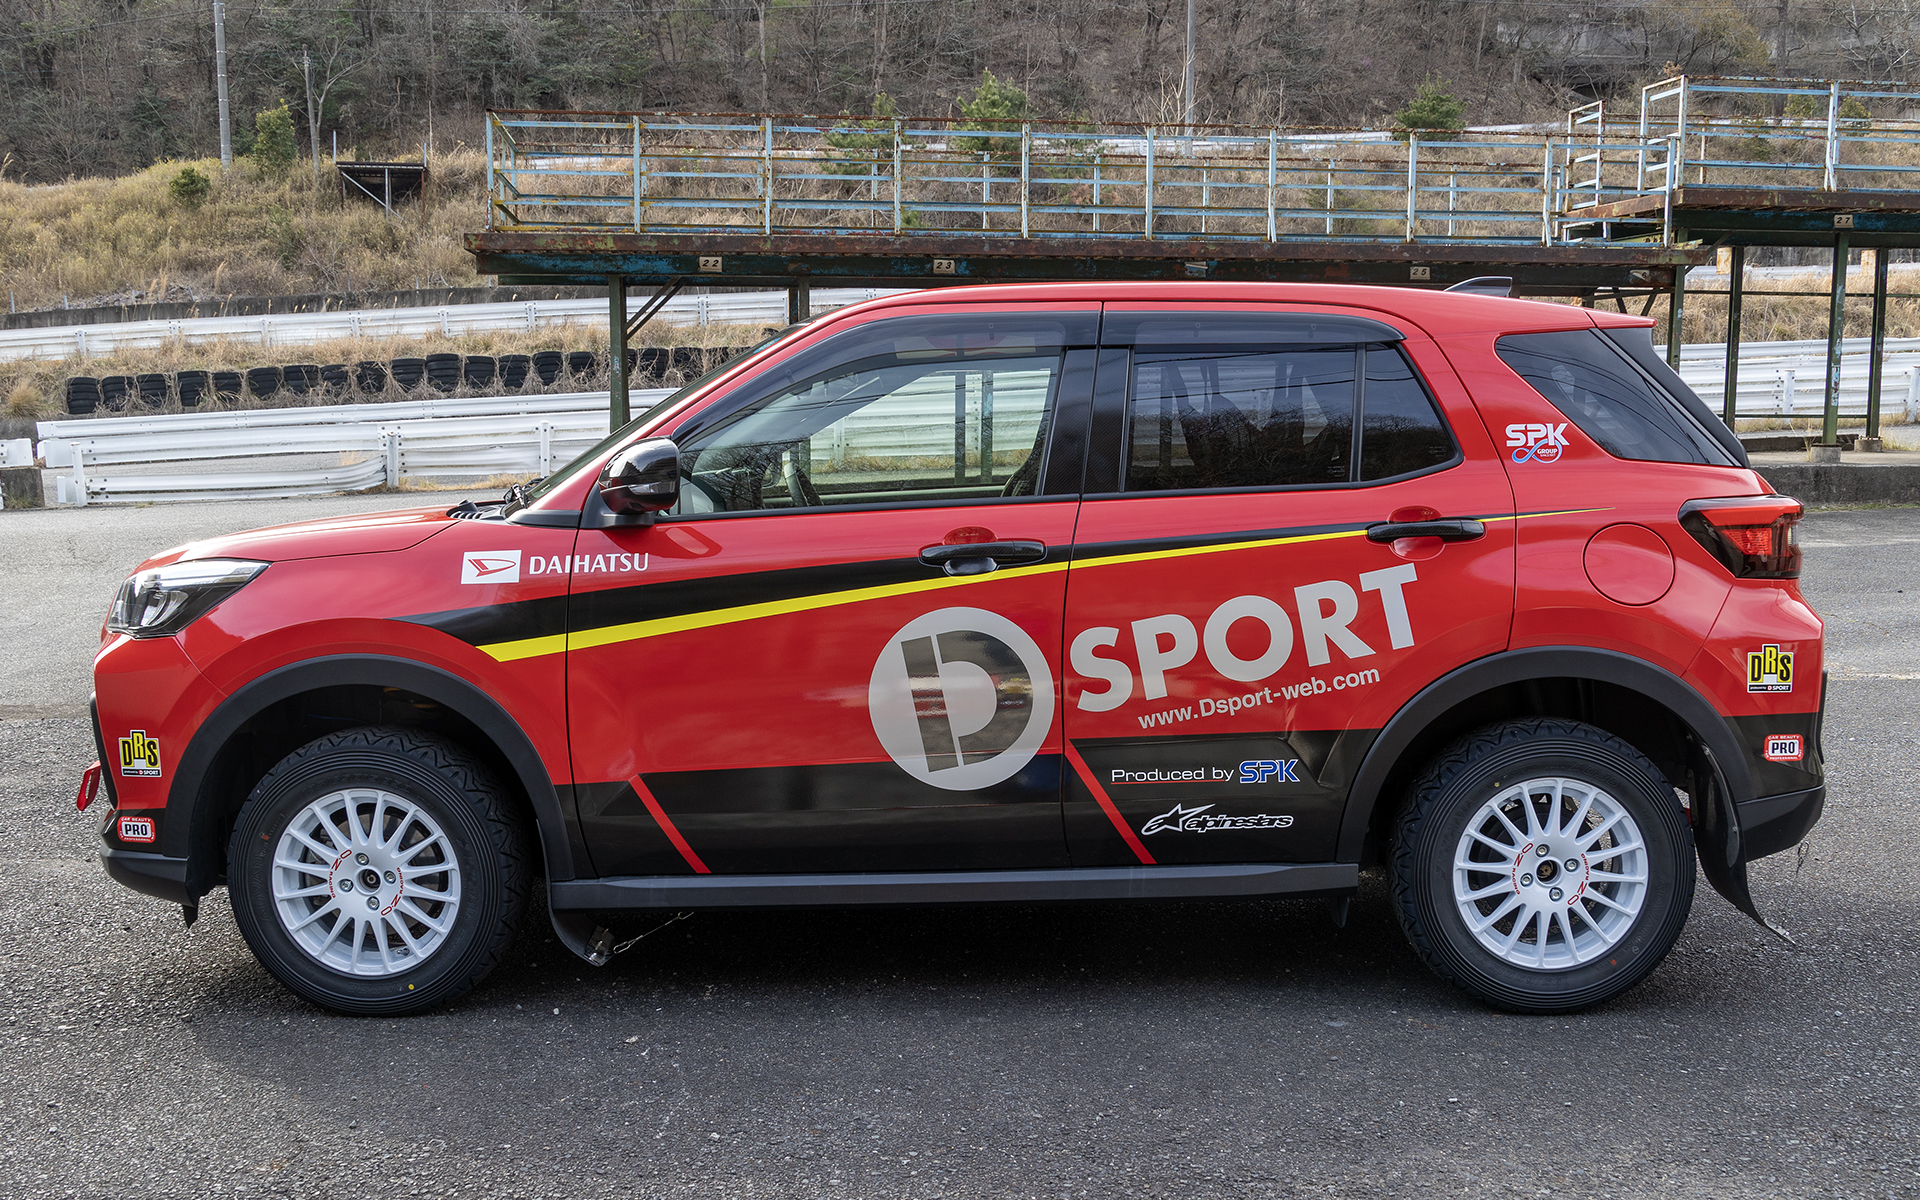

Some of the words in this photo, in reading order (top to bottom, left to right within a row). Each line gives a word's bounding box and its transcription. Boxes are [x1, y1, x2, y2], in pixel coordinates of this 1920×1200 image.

[1836, 216, 1851, 224] 27
[702, 259, 720, 268] 22
[935, 261, 952, 270] 23
[1412, 268, 1428, 276] 25
[1505, 423, 1570, 447] SPK
[529, 552, 649, 575] DAIHATSU
[1070, 563, 1418, 713] SPORT
[1750, 646, 1791, 682] DRS
[1138, 668, 1381, 730] www.Dsport-web.com
[121, 732, 158, 767] DRS
[1771, 741, 1796, 754] PRO
[1111, 767, 1205, 782] Produced
[1212, 766, 1235, 782] by
[1239, 758, 1301, 784] SPK
[124, 823, 148, 836] PRO
[1184, 814, 1295, 834] alpinestars
[1580, 853, 1590, 881] RACING
[328, 871, 337, 899] RACING
[395, 866, 404, 895] RACING
[1511, 867, 1521, 895] RACING
